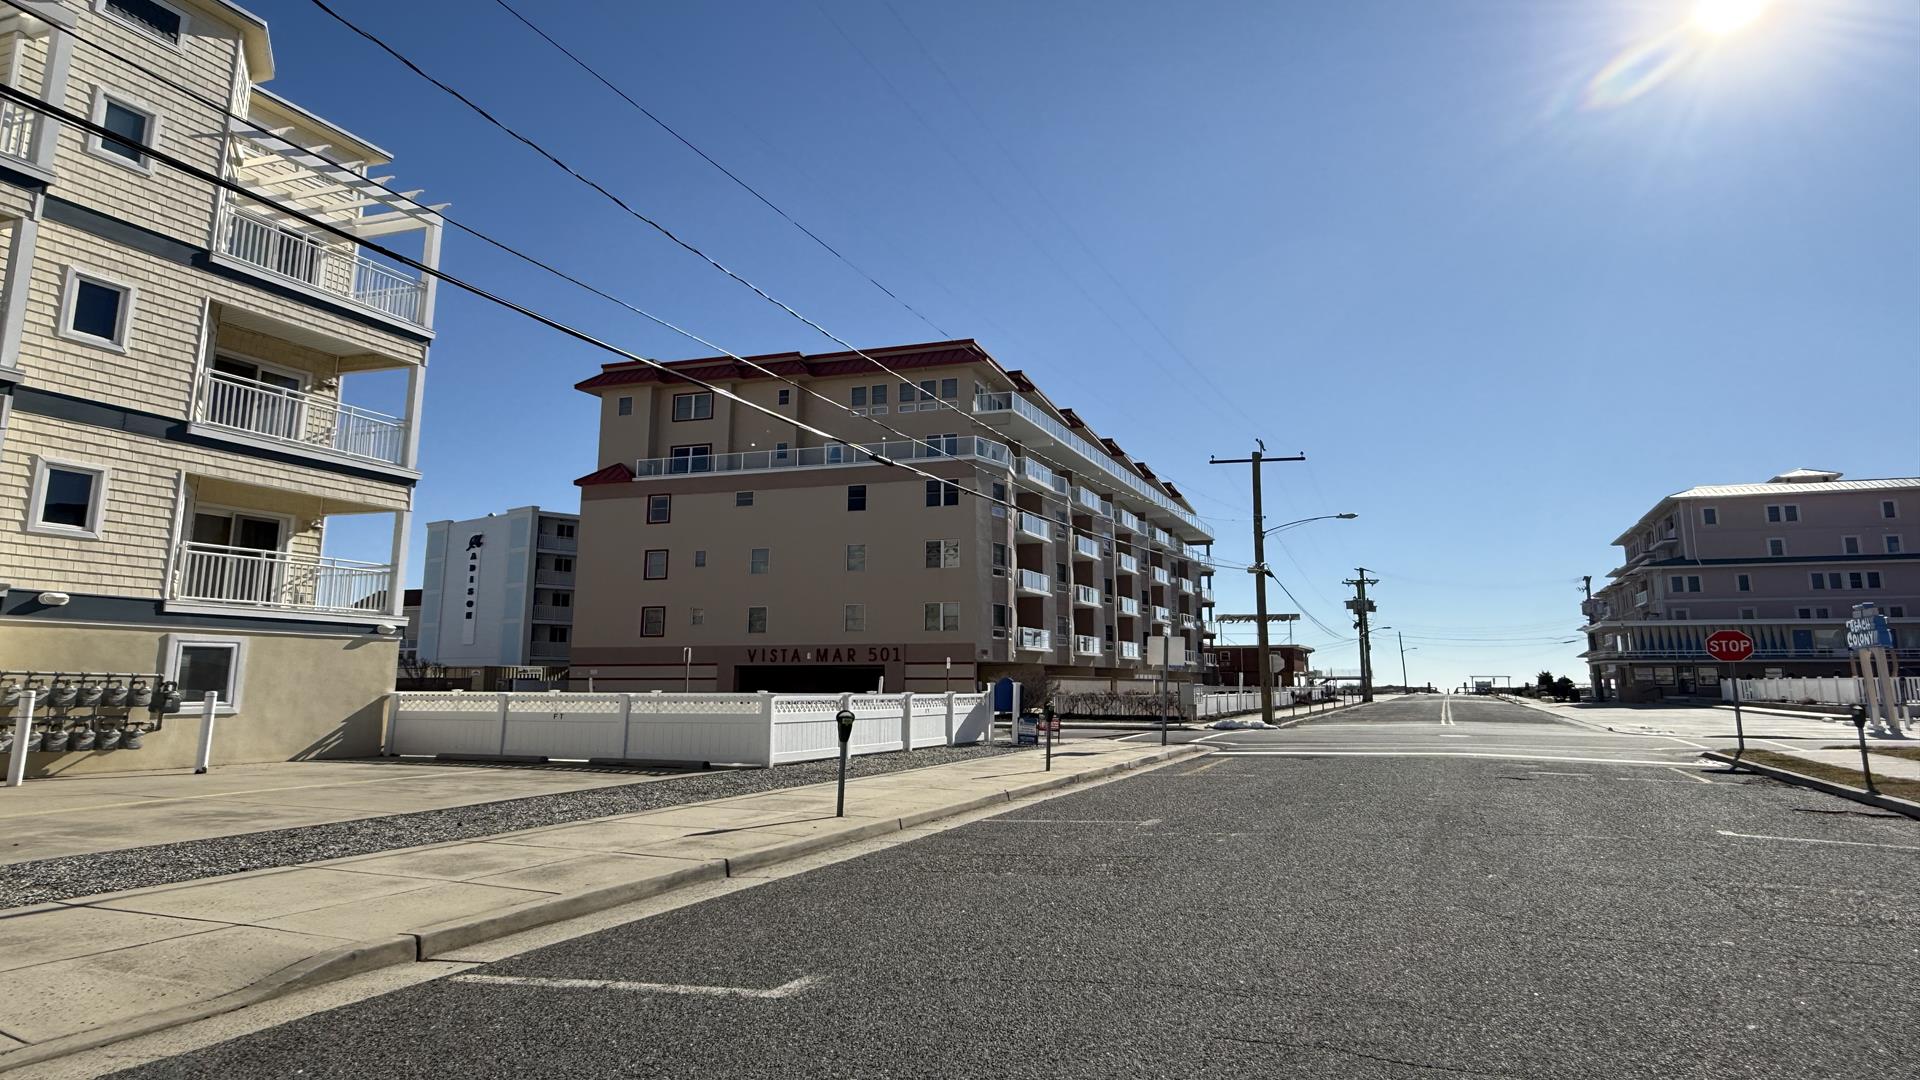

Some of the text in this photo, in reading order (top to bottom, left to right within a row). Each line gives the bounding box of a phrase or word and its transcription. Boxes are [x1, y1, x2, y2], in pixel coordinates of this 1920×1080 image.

[1710, 640, 1750, 652] STOP
[1847, 630, 1873, 647] COLONY
[748, 647, 901, 662] VISTA MAR 501
